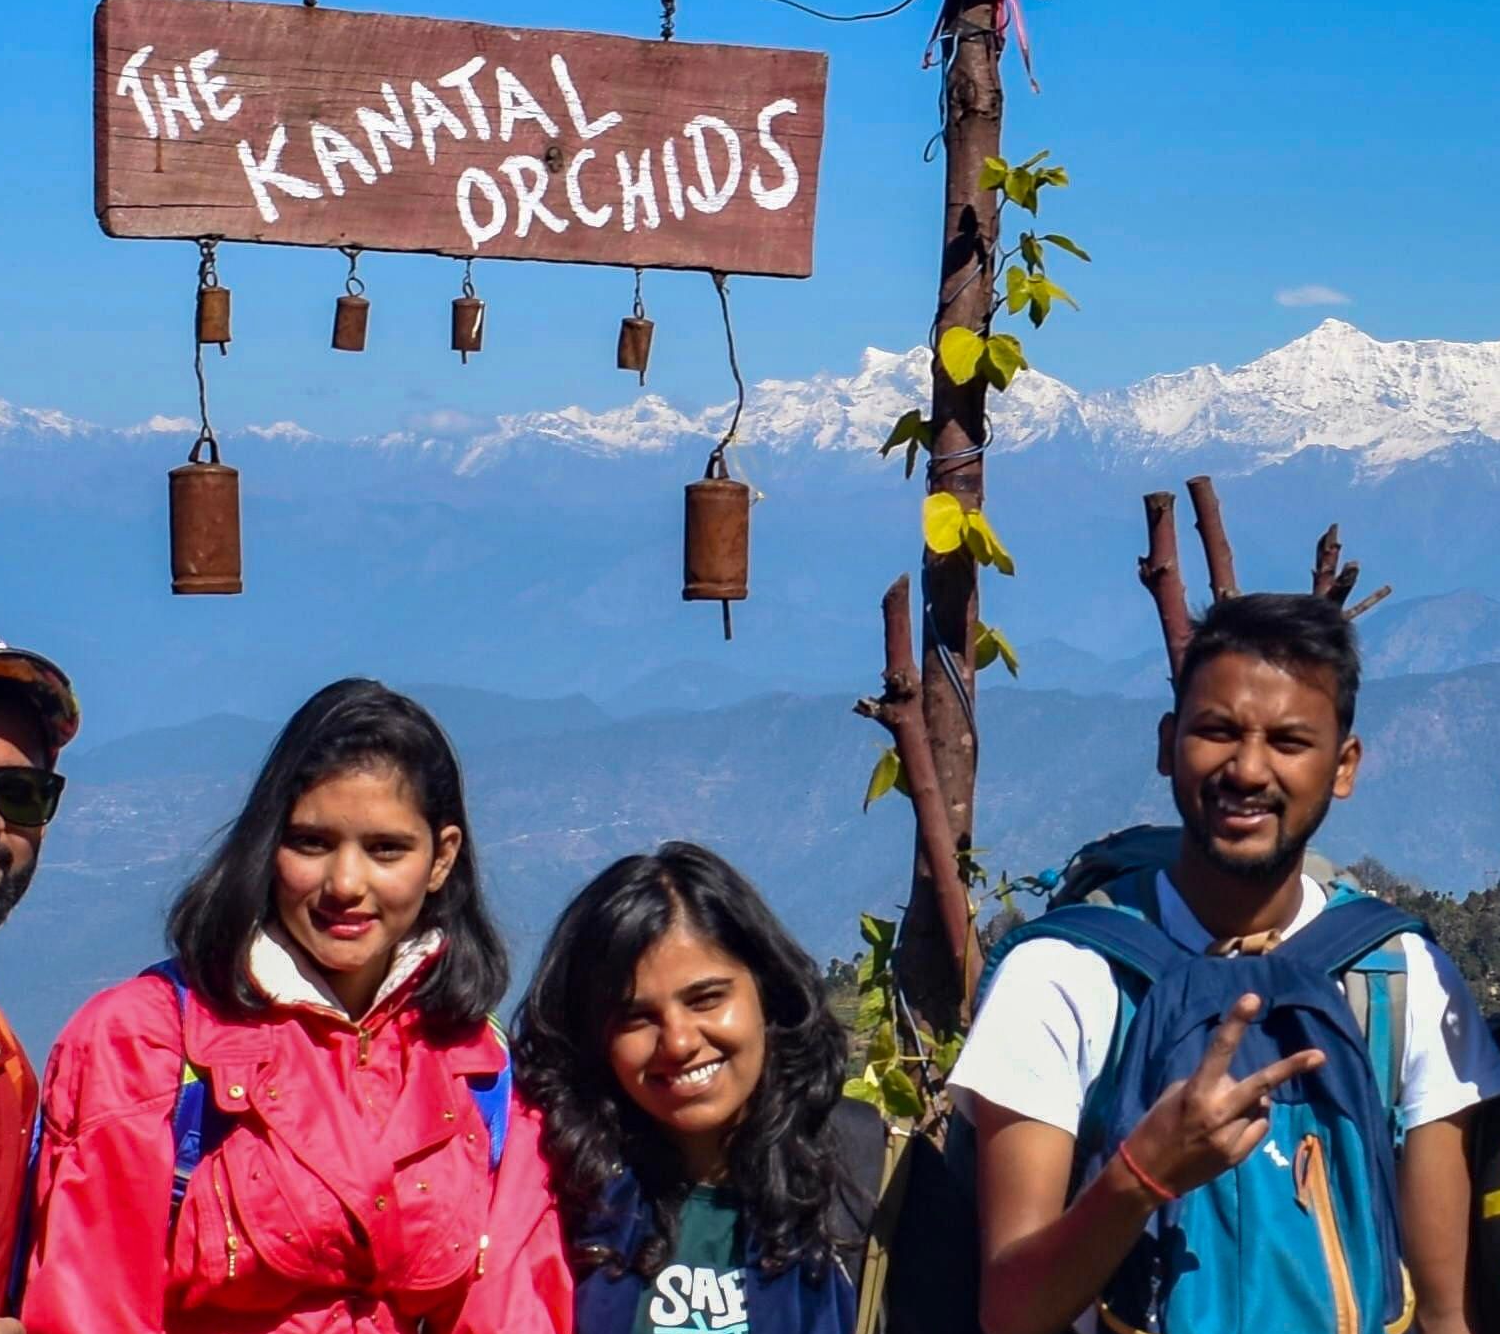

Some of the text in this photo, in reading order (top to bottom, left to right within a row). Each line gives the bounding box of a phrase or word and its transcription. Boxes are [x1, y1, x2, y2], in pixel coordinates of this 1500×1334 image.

[116, 44, 243, 140] THE
[236, 53, 621, 223] KANATAL
[455, 98, 799, 250] ORCHIDS
